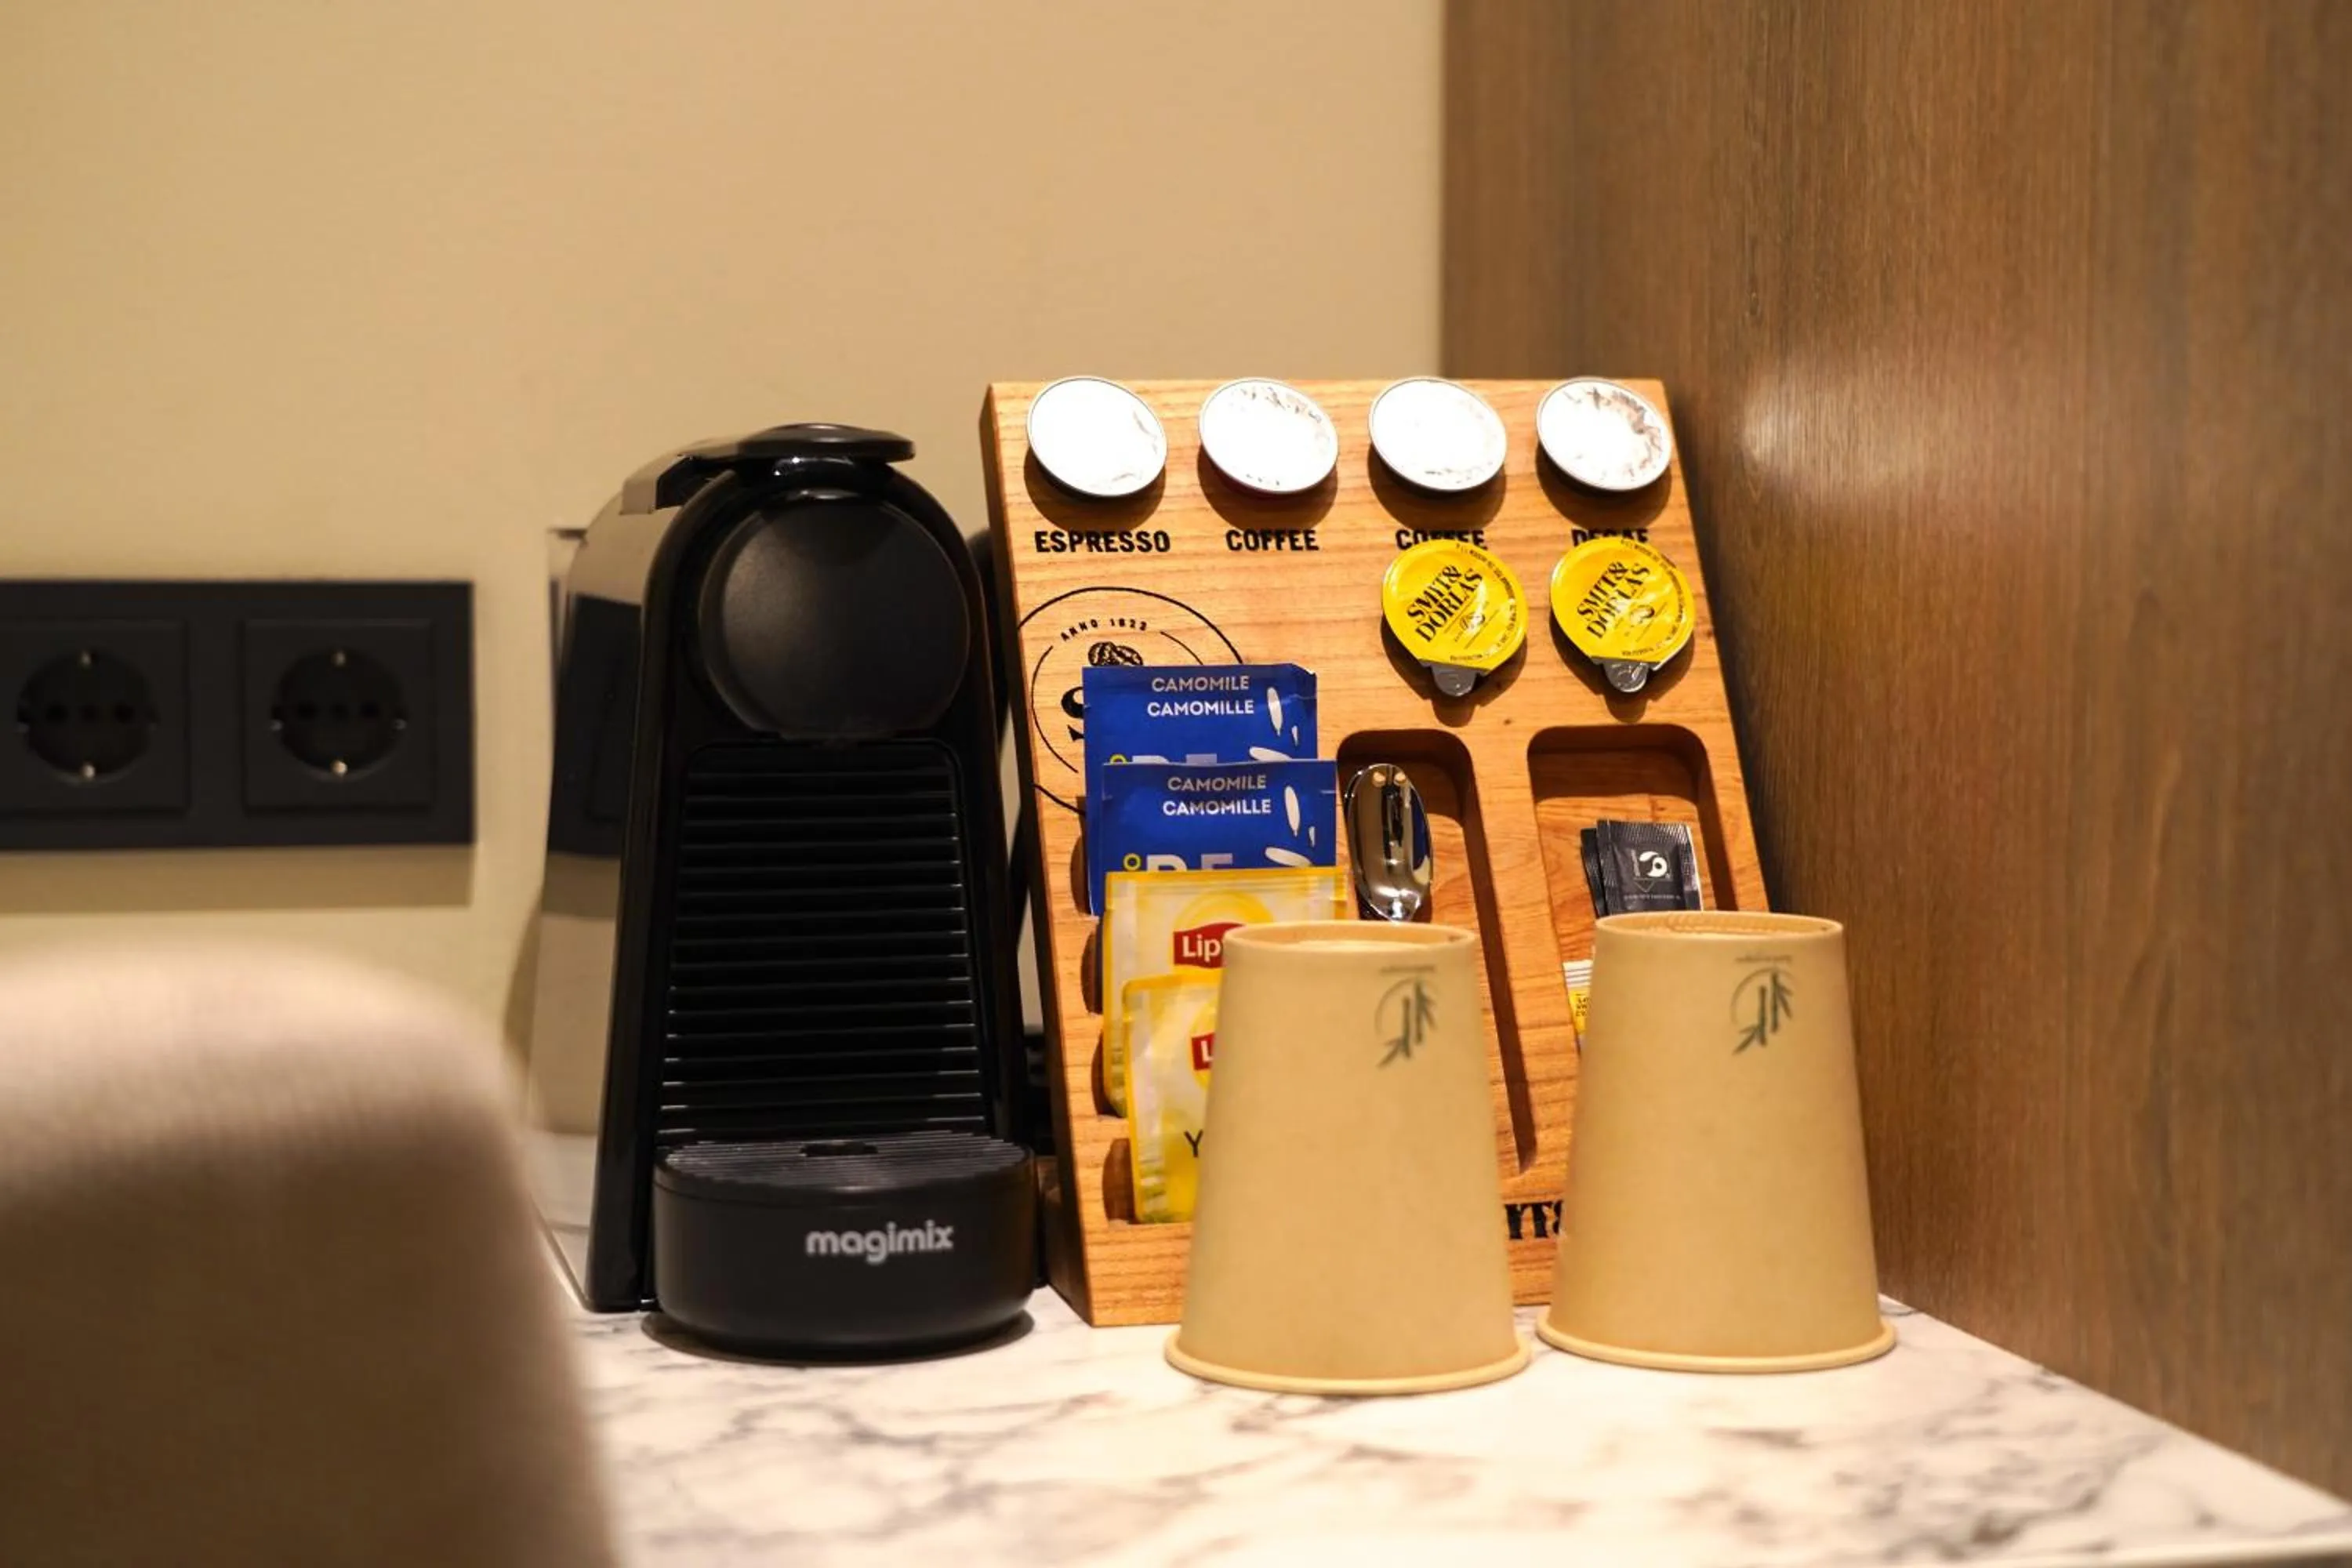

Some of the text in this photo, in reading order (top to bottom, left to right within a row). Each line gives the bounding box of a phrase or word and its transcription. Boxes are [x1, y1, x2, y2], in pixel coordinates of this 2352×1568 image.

[1034, 530, 1171, 553] ESPRESSO
[1225, 528, 1319, 551] COFFEE
[1415, 568, 1483, 642] DORLAS
[1061, 619, 1098, 641] ANNO
[1152, 675, 1250, 692] CAMOMILE
[1147, 699, 1255, 717] CAMOMILLE
[1167, 774, 1267, 792] CAMOMILE
[1162, 799, 1272, 816] CAMOMILLE
[1181, 934, 1221, 962] Lip
[805, 1219, 954, 1265] magimix
